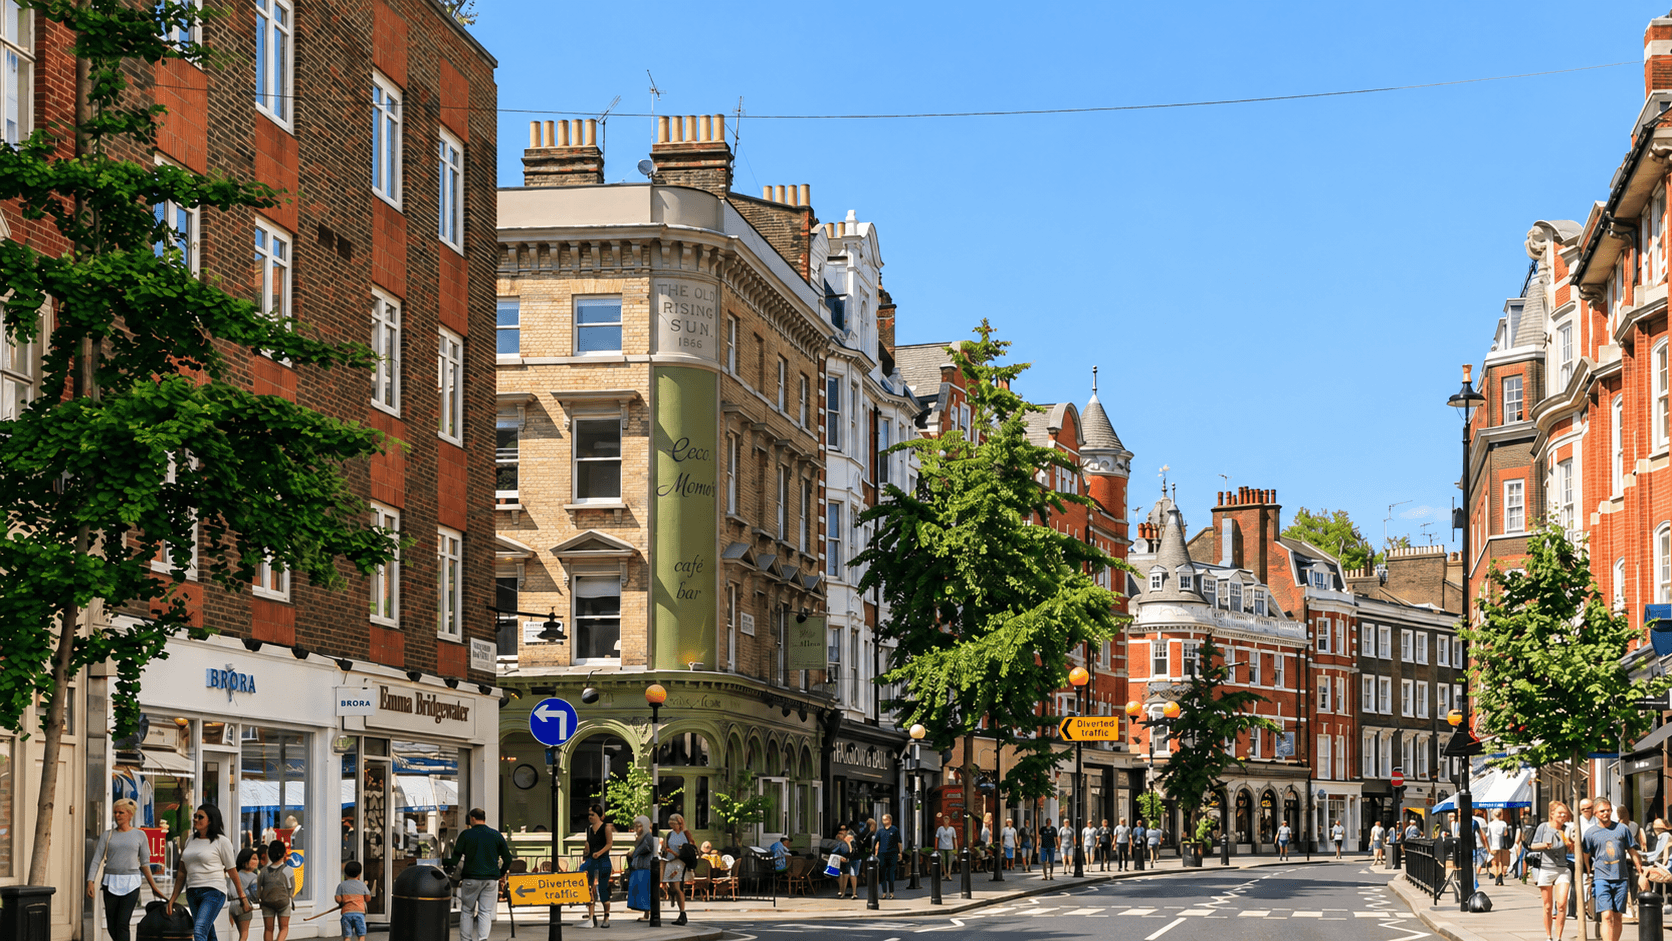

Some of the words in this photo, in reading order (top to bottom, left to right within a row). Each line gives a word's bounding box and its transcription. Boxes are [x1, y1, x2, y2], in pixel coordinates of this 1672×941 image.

[657, 284, 689, 297] THE
[694, 287, 715, 303] OLD
[663, 302, 713, 319] RISING
[678, 337, 702, 348] 1866
[674, 554, 704, 578] café
[676, 581, 701, 599] bar
[206, 668, 257, 693] BRORA
[379, 685, 413, 713] Emma
[415, 692, 470, 723] Bridgewater
[1077, 719, 1115, 728] Diverted
[1081, 728, 1109, 737] traffic
[149, 837, 165, 856] LE
[538, 879, 585, 889] Diverted
[545, 889, 579, 899] traffic
